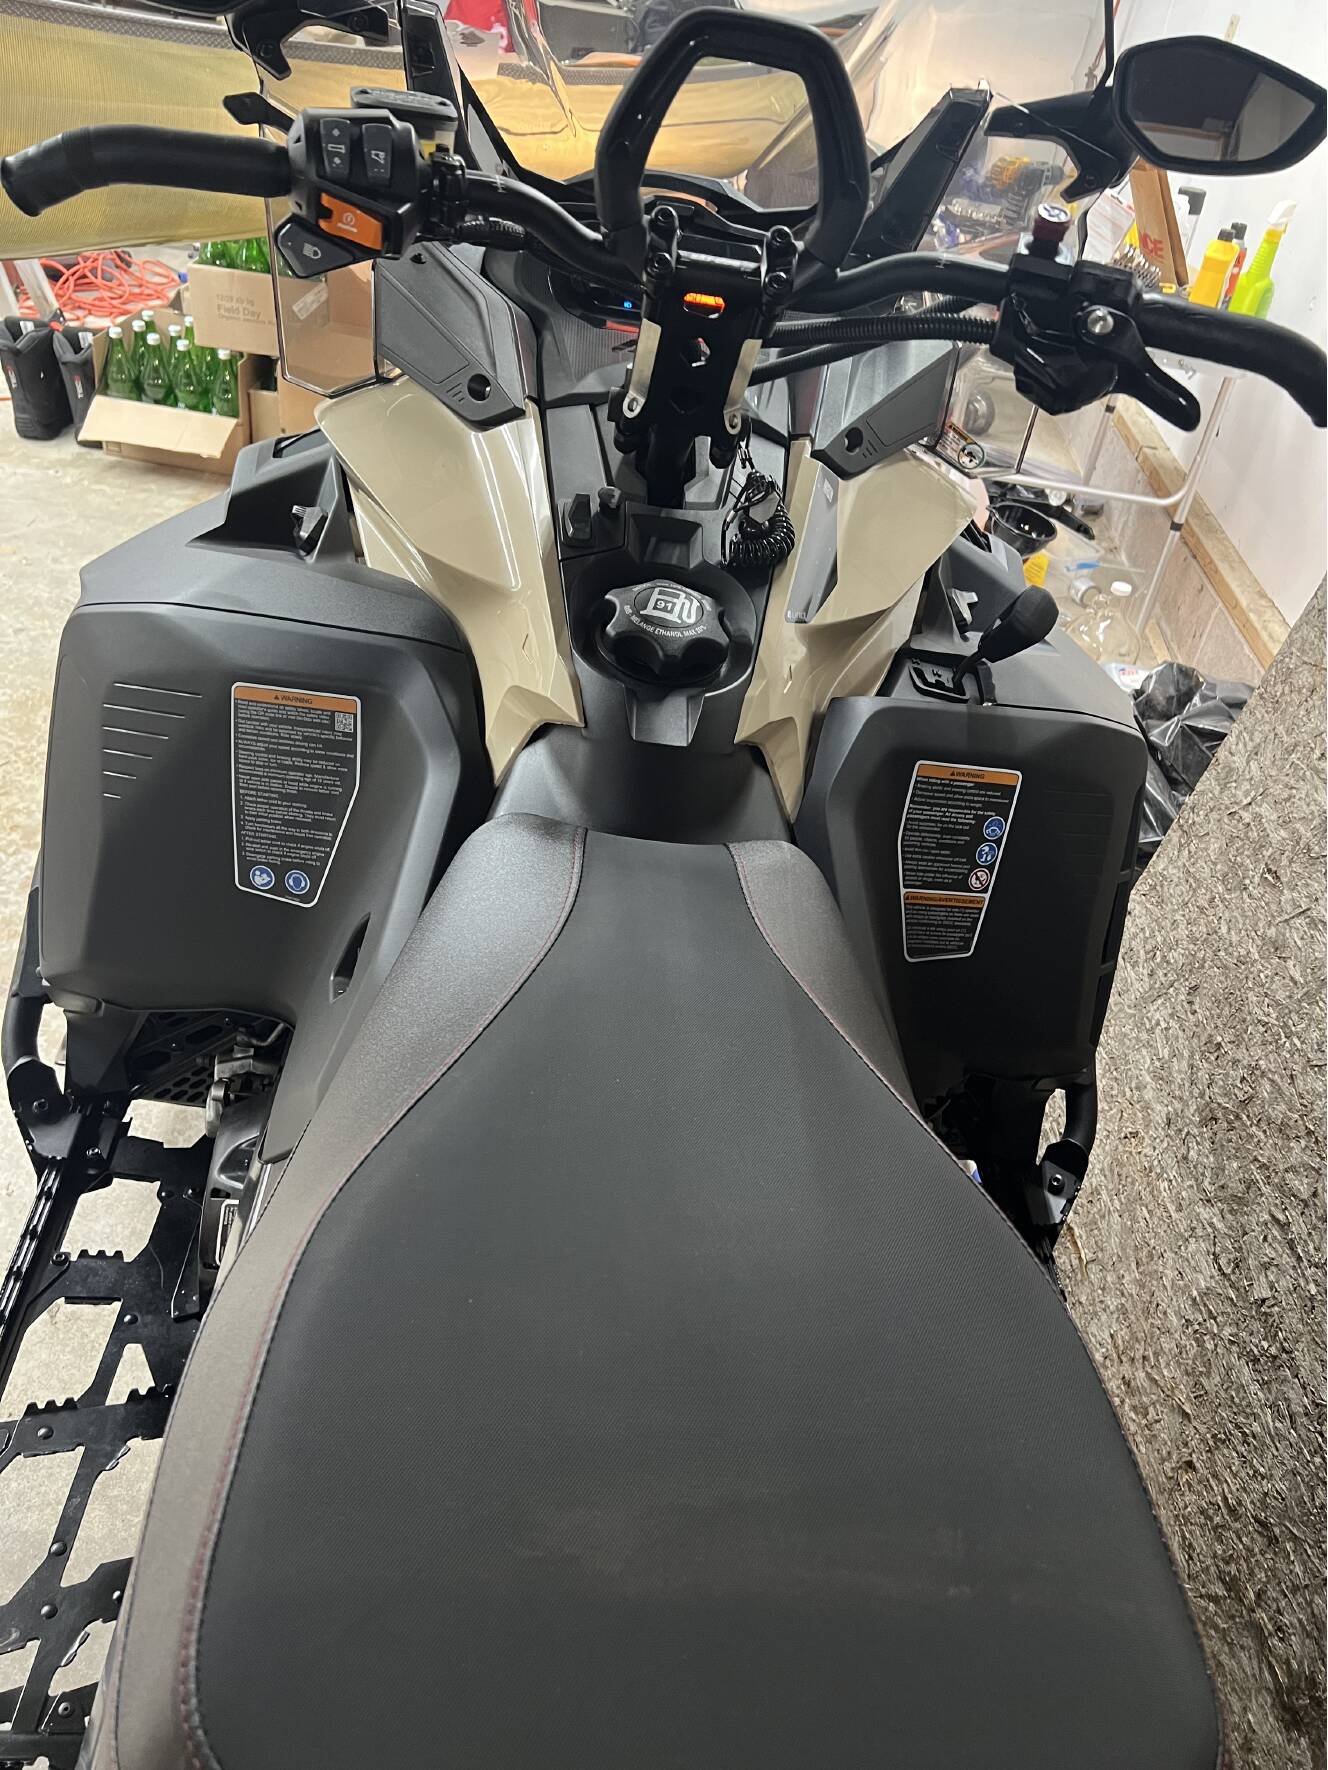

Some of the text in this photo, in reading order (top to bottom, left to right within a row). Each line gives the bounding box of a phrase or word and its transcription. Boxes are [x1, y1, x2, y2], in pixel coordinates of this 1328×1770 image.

[242, 307, 261, 320] Day
[656, 600, 673, 611] 91
[654, 628, 683, 638] ETHANOL
[281, 695, 313, 705] WARNING
[955, 771, 985, 780] WARNING
